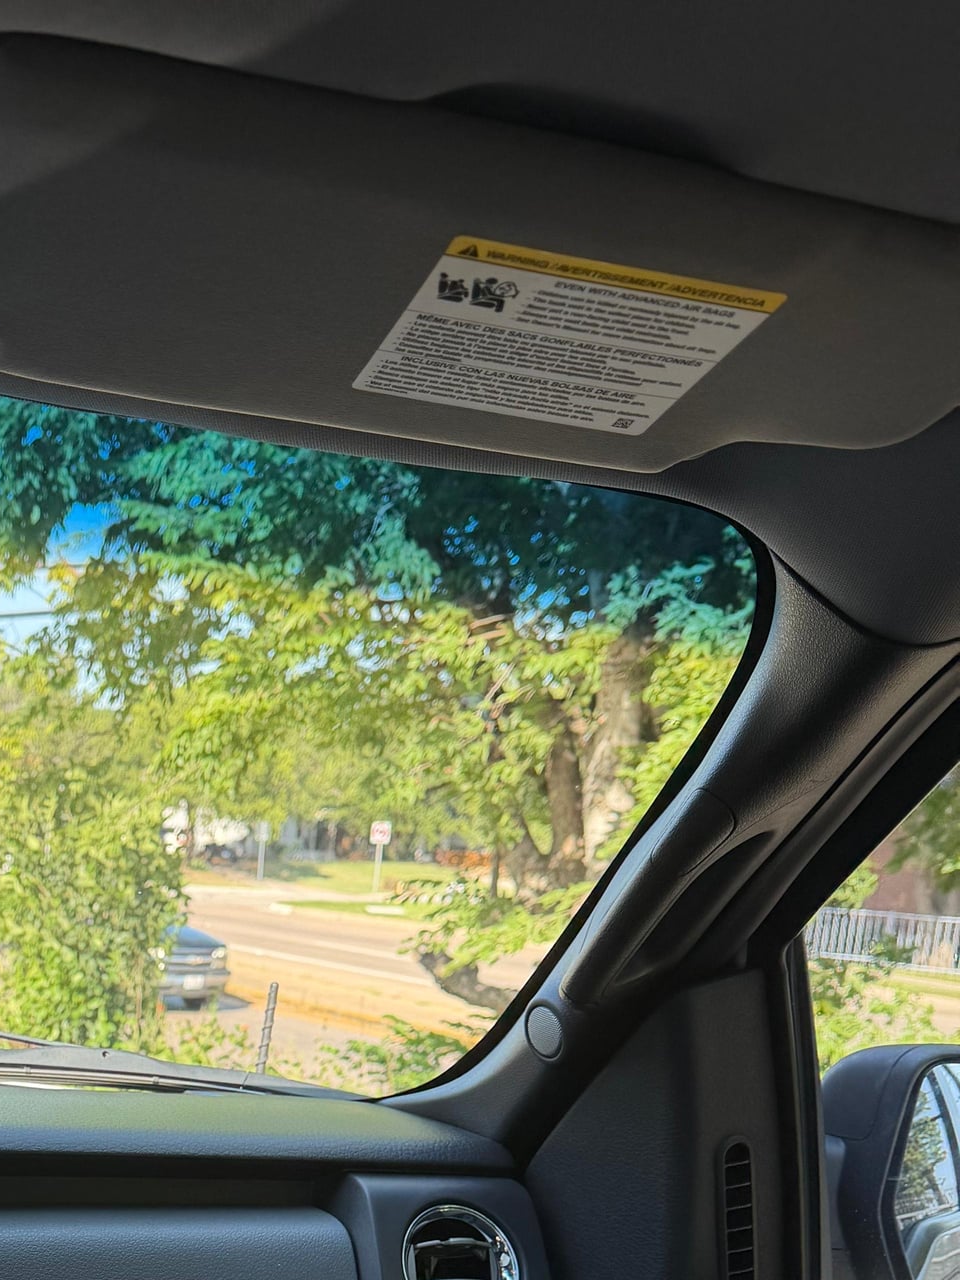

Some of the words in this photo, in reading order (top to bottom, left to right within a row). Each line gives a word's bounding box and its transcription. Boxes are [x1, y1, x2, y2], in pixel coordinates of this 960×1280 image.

[487, 250, 549, 268] WARNING
[553, 280, 588, 291] EVEN
[586, 286, 618, 297] WITH
[617, 292, 682, 308] ADVANCED
[680, 303, 703, 312] AIR
[701, 307, 736, 318] BAGS
[450, 320, 481, 329] AVEC
[482, 326, 506, 334] DES
[506, 330, 538, 340] SACS
[538, 335, 613, 352] GONFLABLES
[400, 355, 457, 369] INCLUSIVE
[457, 365, 482, 373] CON
[506, 373, 549, 385] NUEVAS
[550, 381, 594, 392] BOLSAS
[609, 391, 637, 400] AIRE
